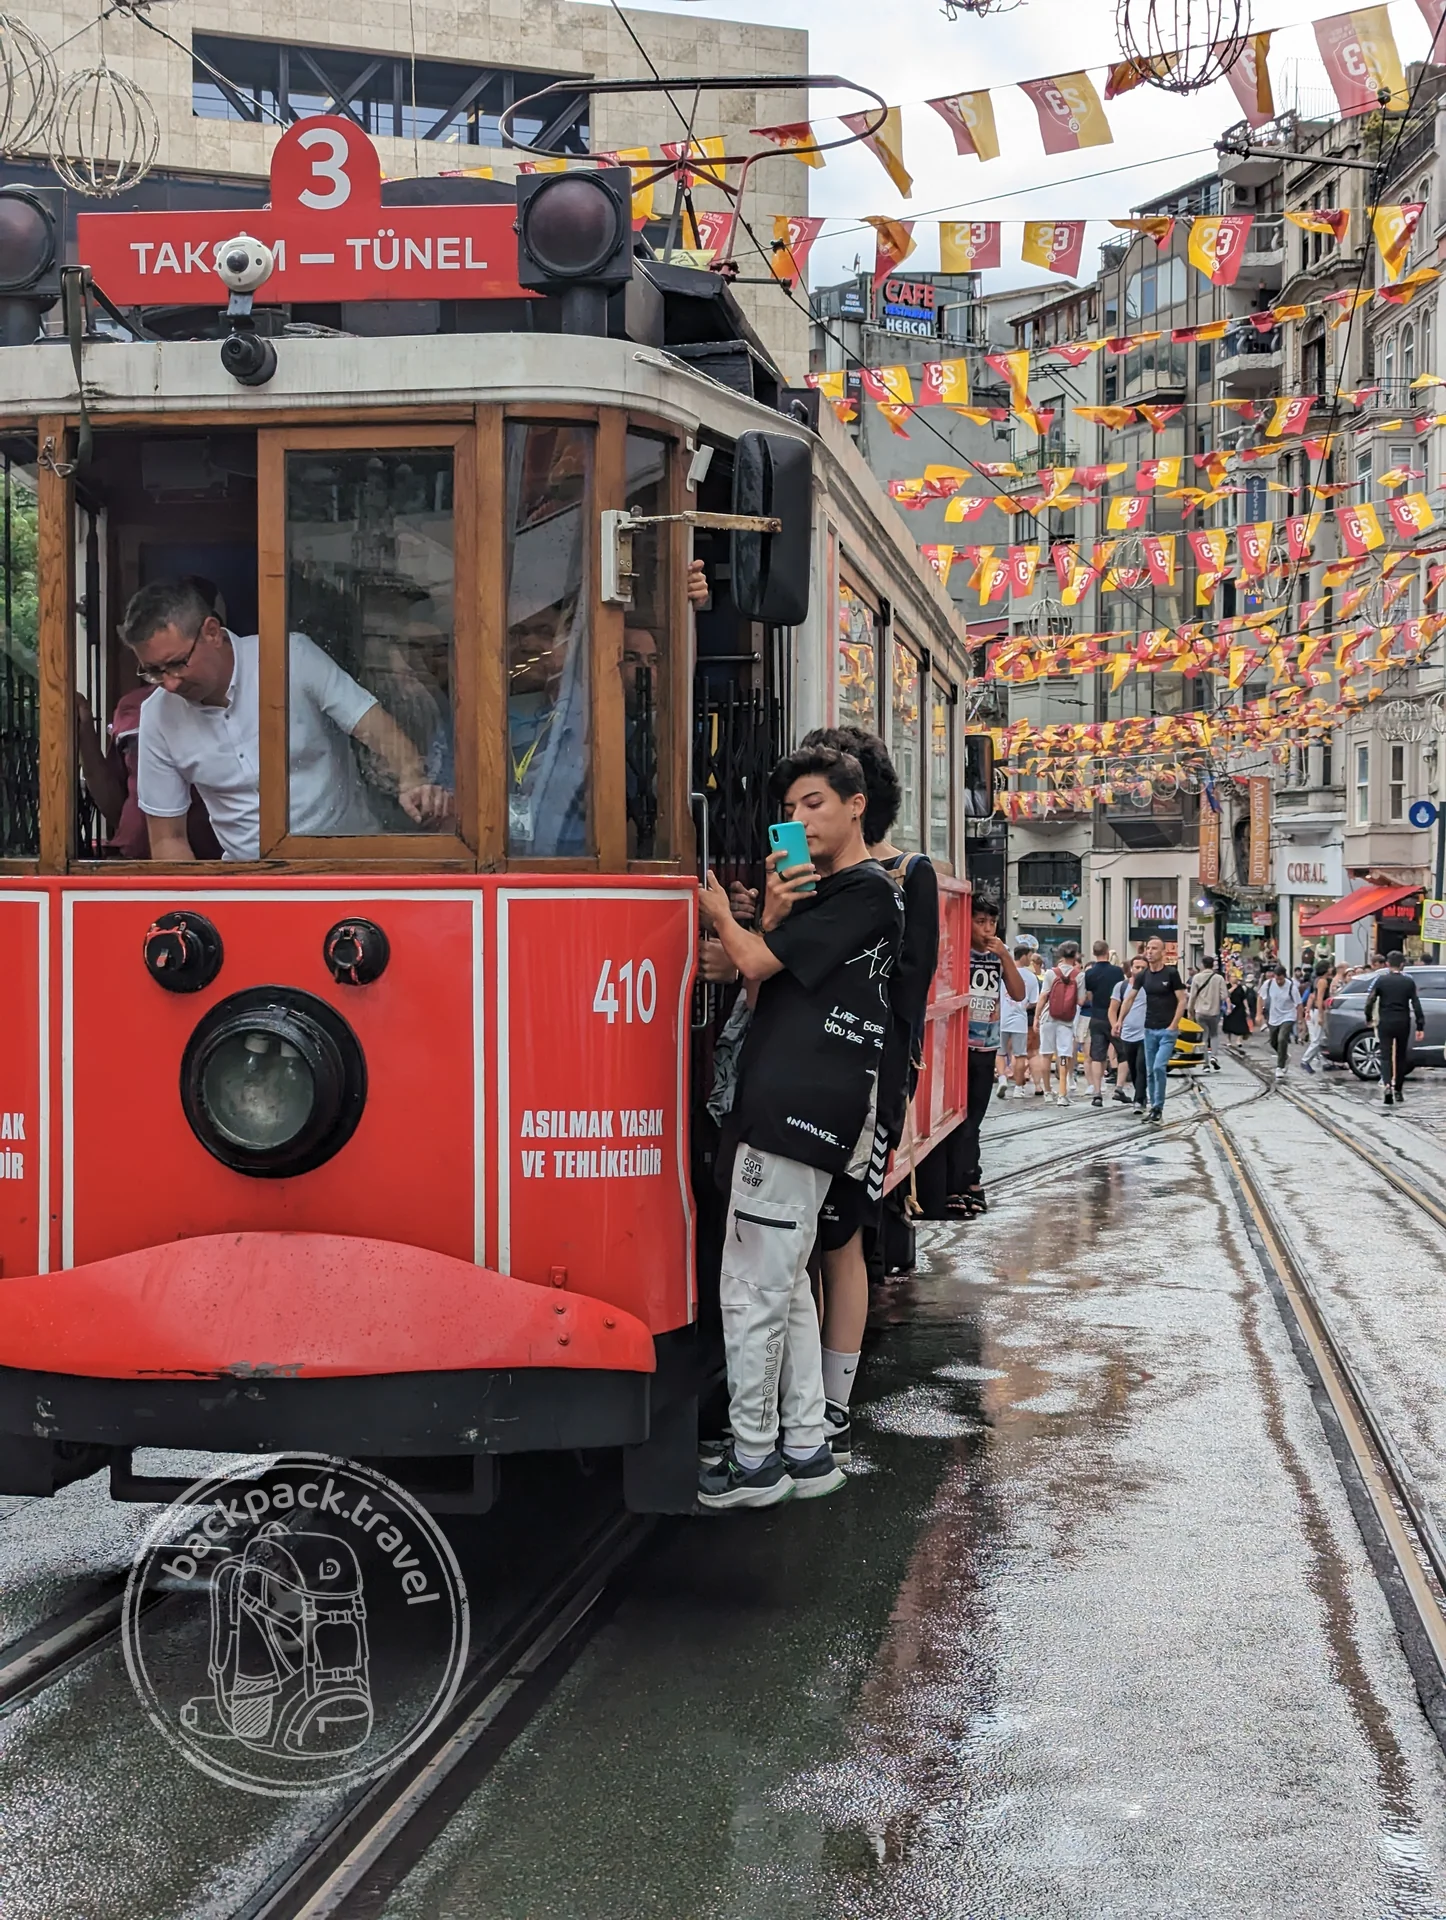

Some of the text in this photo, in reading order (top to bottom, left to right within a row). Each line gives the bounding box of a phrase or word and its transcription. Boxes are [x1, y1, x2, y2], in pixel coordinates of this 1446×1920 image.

[297, 127, 352, 210] 3
[955, 223, 986, 245] 23
[1201, 227, 1234, 256] 23
[346, 228, 488, 271] TÜNEL
[885, 279, 936, 308] CAFE
[1207, 841, 1216, 879] KURSU
[1287, 863, 1327, 884] CORAL
[1035, 898, 1065, 910] Telekom
[1133, 898, 1177, 919] flormar
[593, 958, 657, 1024] 410
[970, 968, 999, 992] OS
[830, 1005, 885, 1035] LIFE GOES
[521, 1109, 663, 1138] ASILMAK YASAK
[521, 1144, 662, 1178] VE TEHLİKELİDİR
[763, 1327, 780, 1397] ACTING
